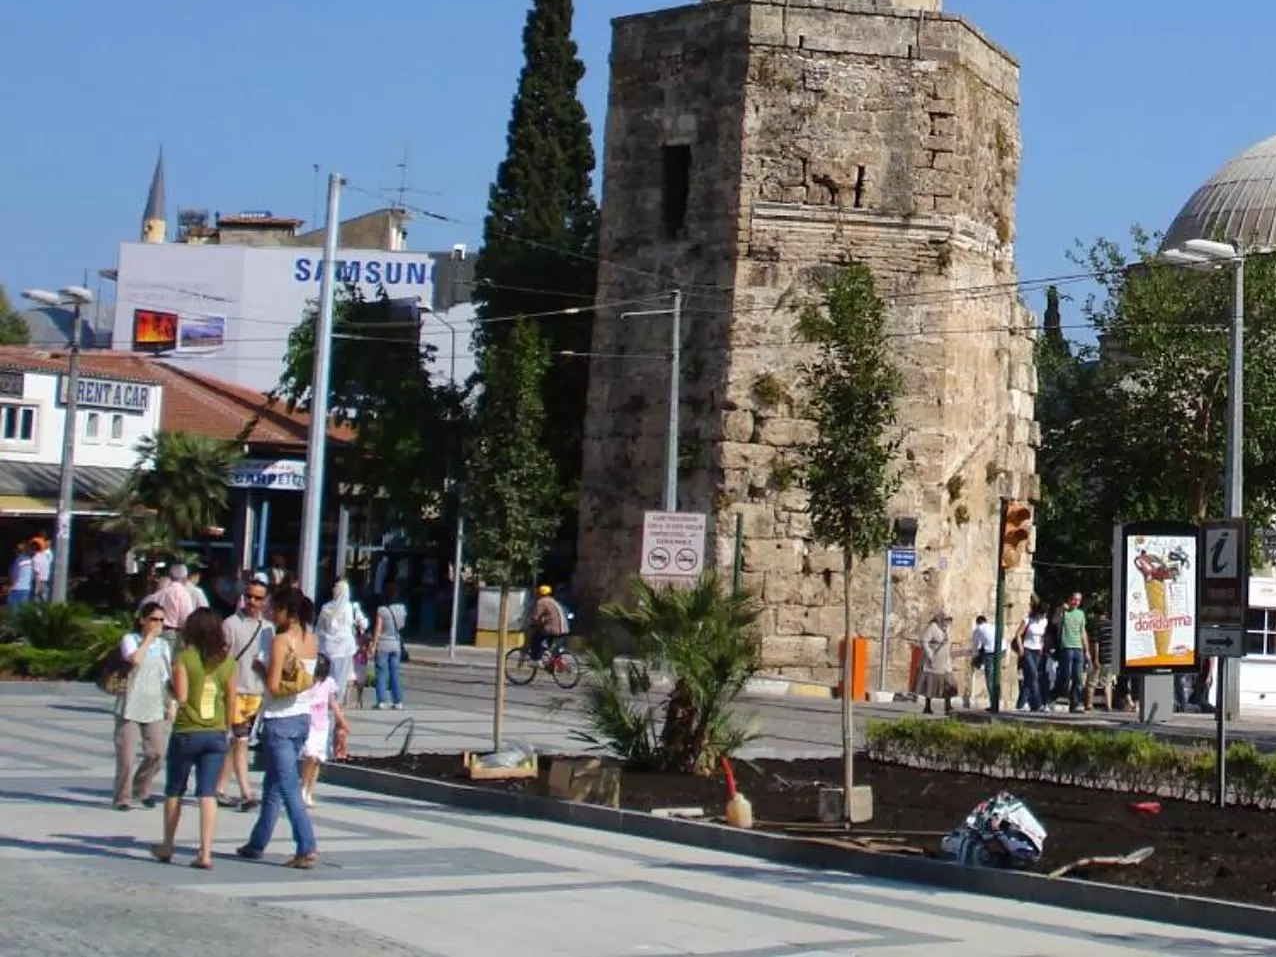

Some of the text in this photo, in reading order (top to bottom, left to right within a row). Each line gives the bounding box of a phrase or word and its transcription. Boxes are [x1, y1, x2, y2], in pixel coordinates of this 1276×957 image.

[294, 258, 437, 285] SAMSUN
[77, 380, 149, 408] RENT A CAR
